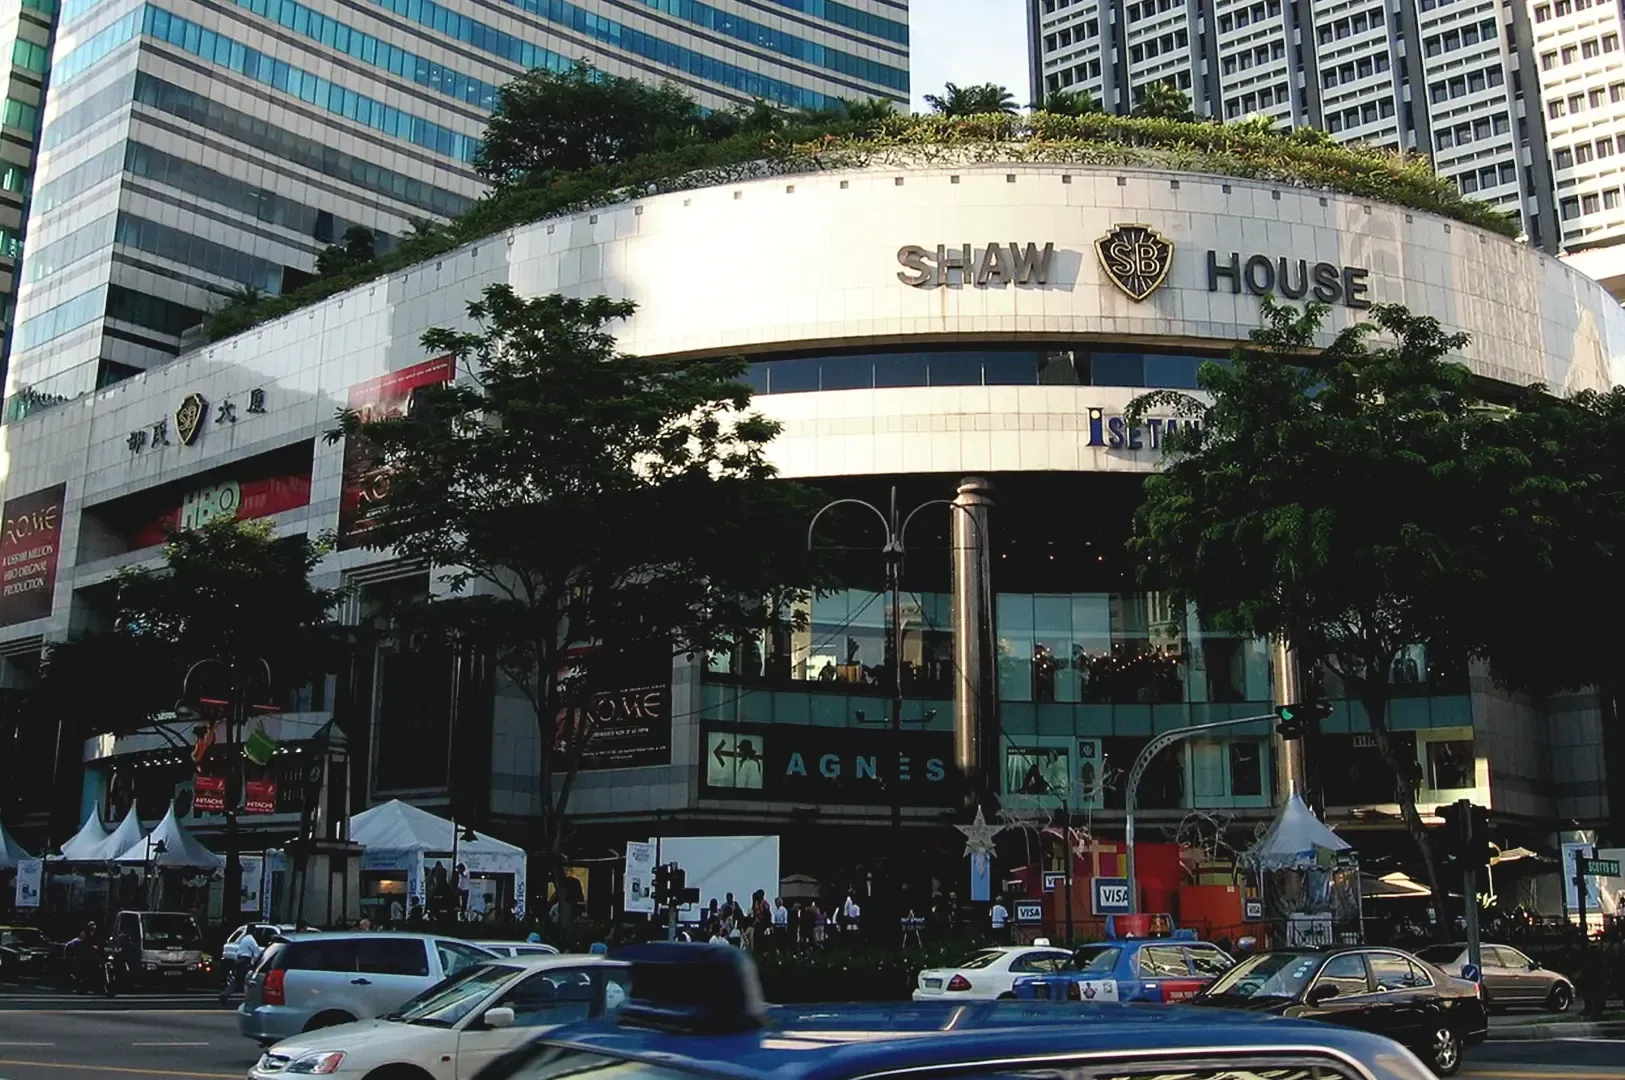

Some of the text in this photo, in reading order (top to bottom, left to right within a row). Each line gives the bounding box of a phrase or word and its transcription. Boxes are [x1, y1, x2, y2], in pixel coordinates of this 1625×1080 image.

[896, 241, 1055, 288] SHAW
[1109, 239, 1161, 278] SB
[1206, 250, 1372, 309] HOUSE
[6, 505, 58, 545] ROME
[181, 481, 240, 532] HBO
[195, 797, 224, 805] HITACHI
[246, 801, 273, 809] HITACHI
[1588, 861, 1619, 874] SCOTTS RD
[1019, 908, 1041, 917] VISA
